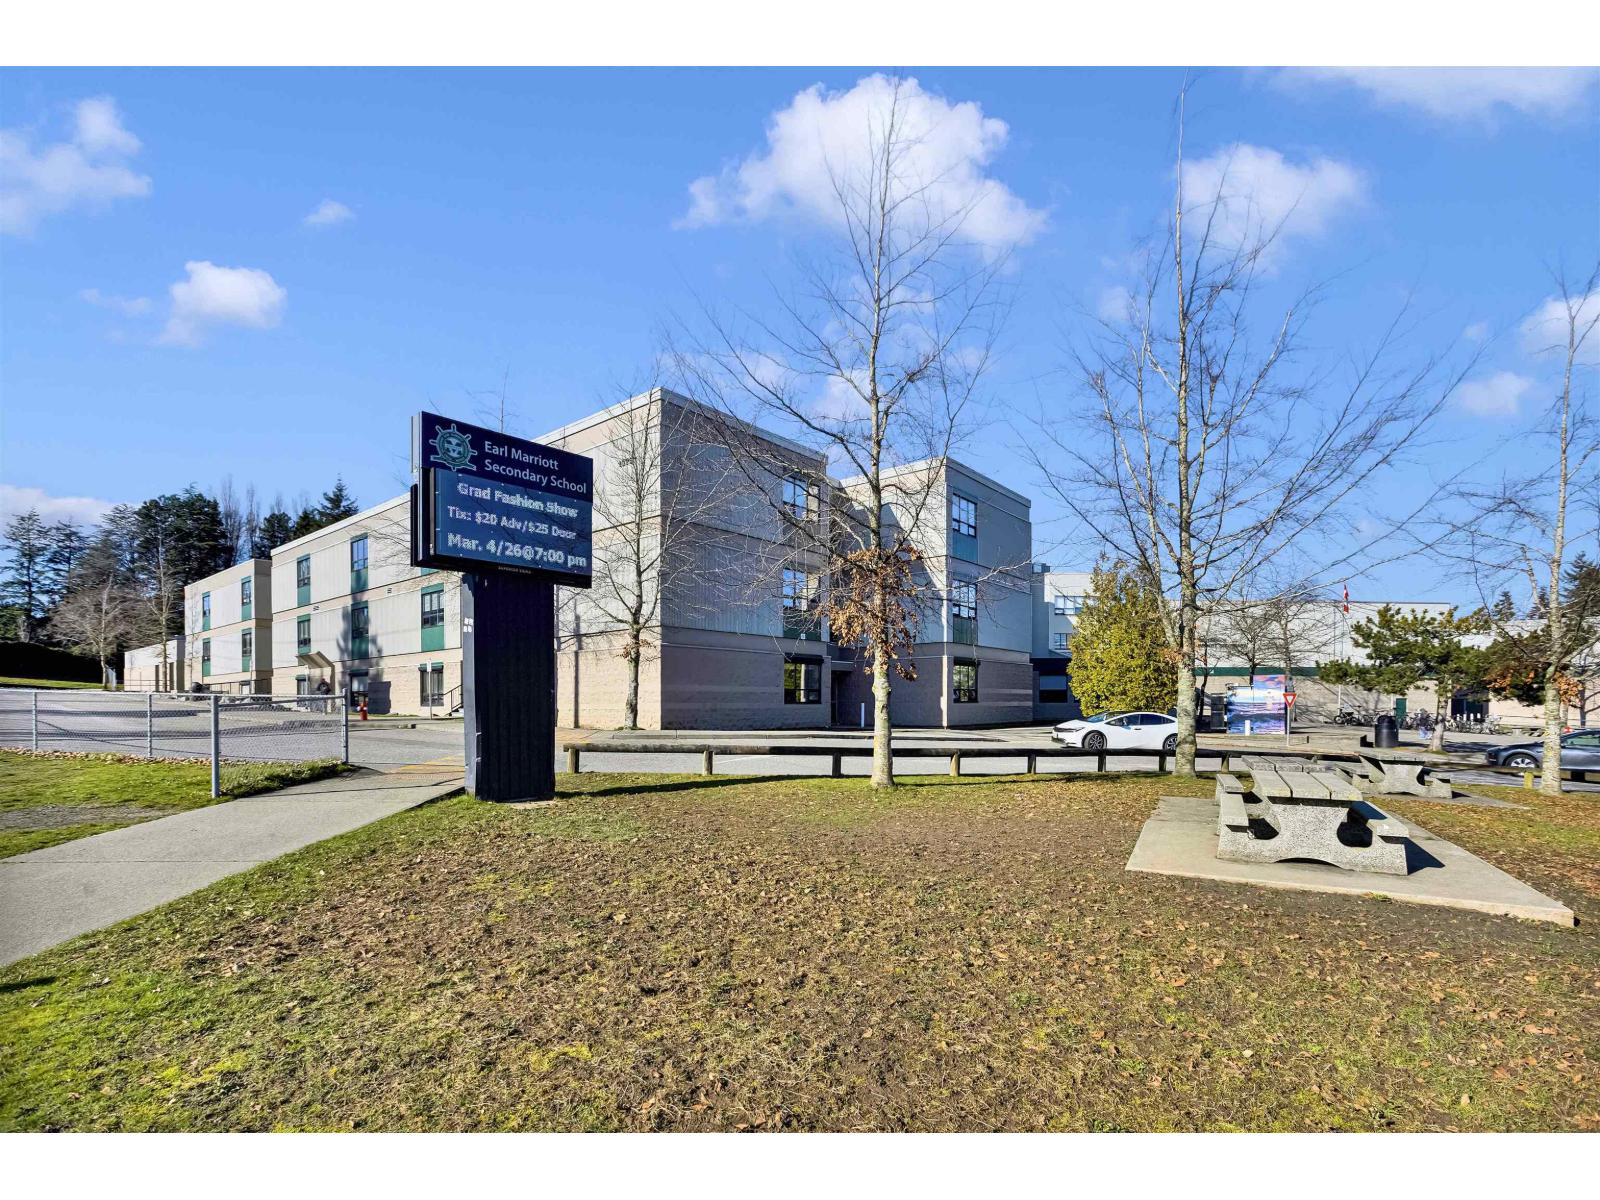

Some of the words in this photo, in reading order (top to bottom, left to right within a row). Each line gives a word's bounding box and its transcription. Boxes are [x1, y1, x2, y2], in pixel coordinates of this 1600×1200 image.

[484, 440, 508, 457] Earl
[511, 448, 559, 471] Marriott
[484, 459, 547, 487] Secondary
[550, 476, 587, 494] School
[457, 482, 491, 500] Grad
[495, 491, 544, 511] Fashion
[546, 501, 579, 518] Show
[447, 505, 472, 521] Tix:
[475, 509, 497, 525] $20
[500, 515, 549, 534] Adv/$25
[552, 527, 577, 540] Door
[447, 532, 483, 552] Mar.
[486, 540, 565, 563] 4/26@7:00
[567, 555, 587, 568] pm
